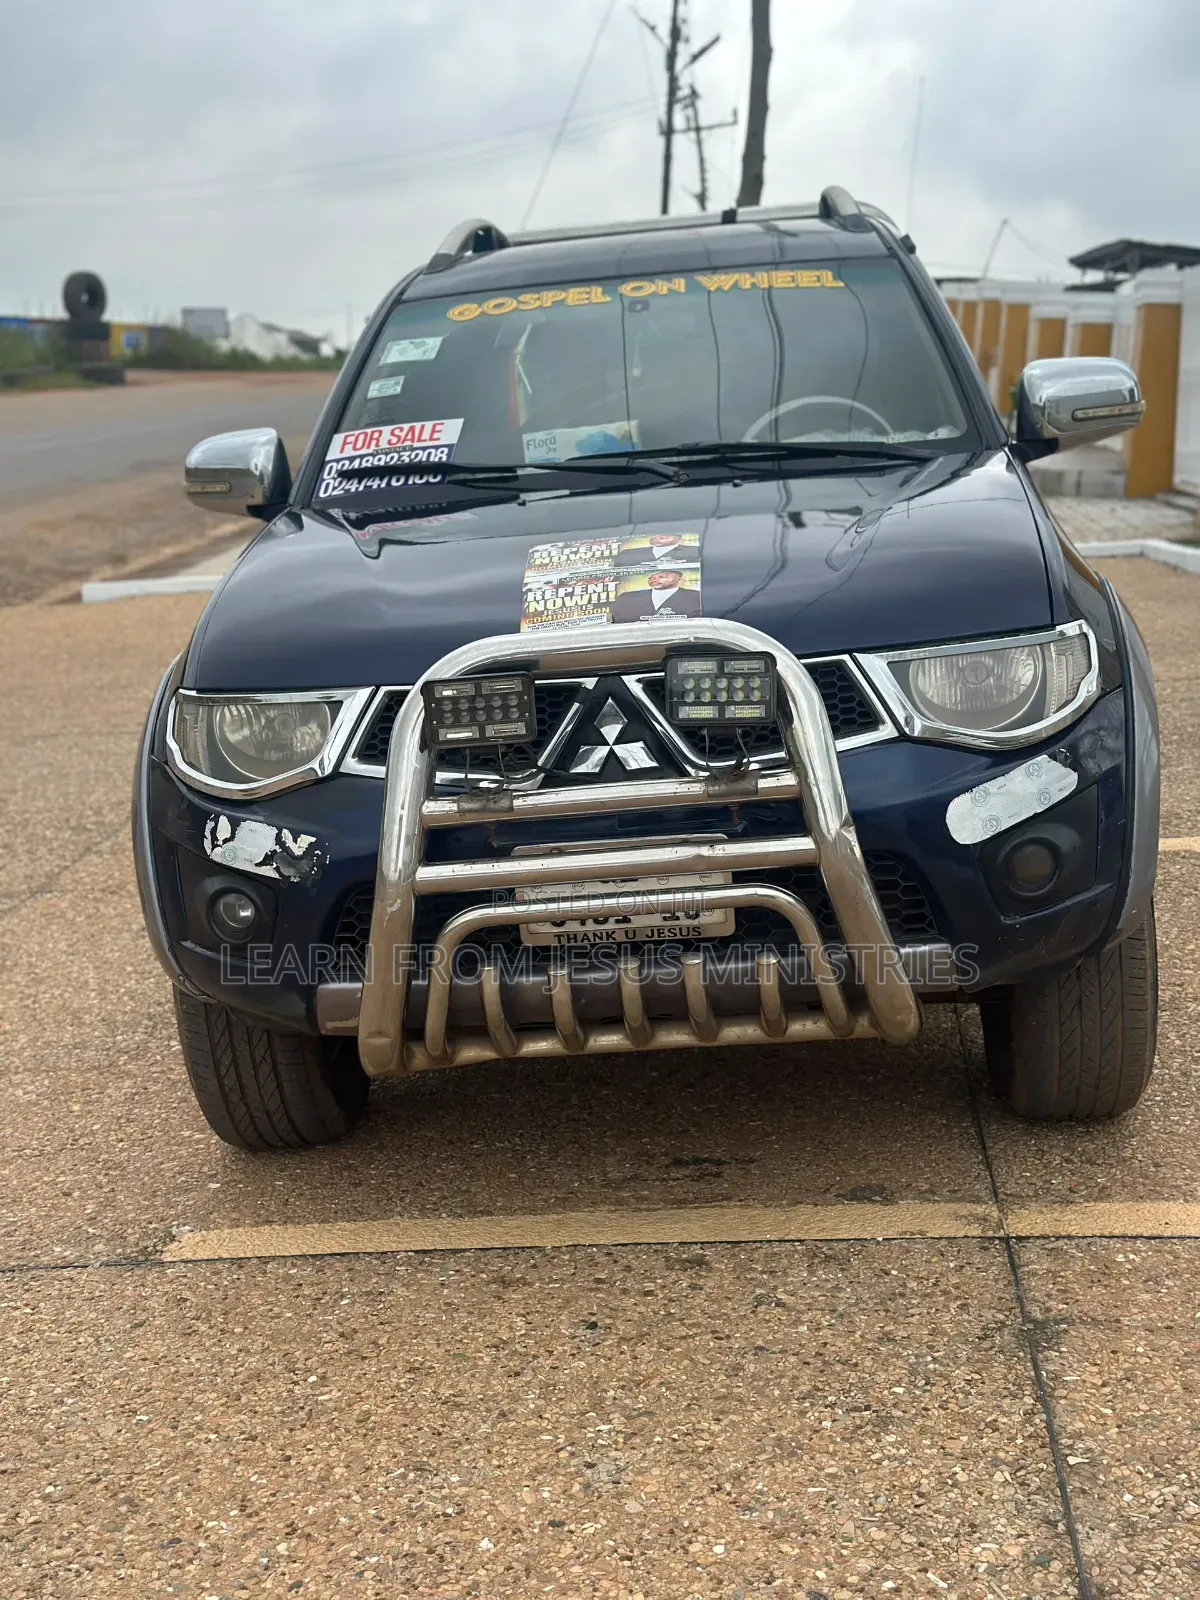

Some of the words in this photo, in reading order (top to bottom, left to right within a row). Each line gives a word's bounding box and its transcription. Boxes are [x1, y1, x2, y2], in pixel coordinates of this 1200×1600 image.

[447, 285, 611, 321] GOSPEL
[618, 277, 685, 297] ON
[694, 270, 844, 292] WHEEL
[339, 429, 383, 454] FOR
[387, 422, 444, 447] SALE
[527, 581, 620, 602] REPENT
[528, 591, 616, 613] NOW!!!
[525, 612, 575, 625] COMING
[554, 930, 617, 945] THANK
[625, 929, 637, 940] U
[645, 926, 702, 939] JESUS
